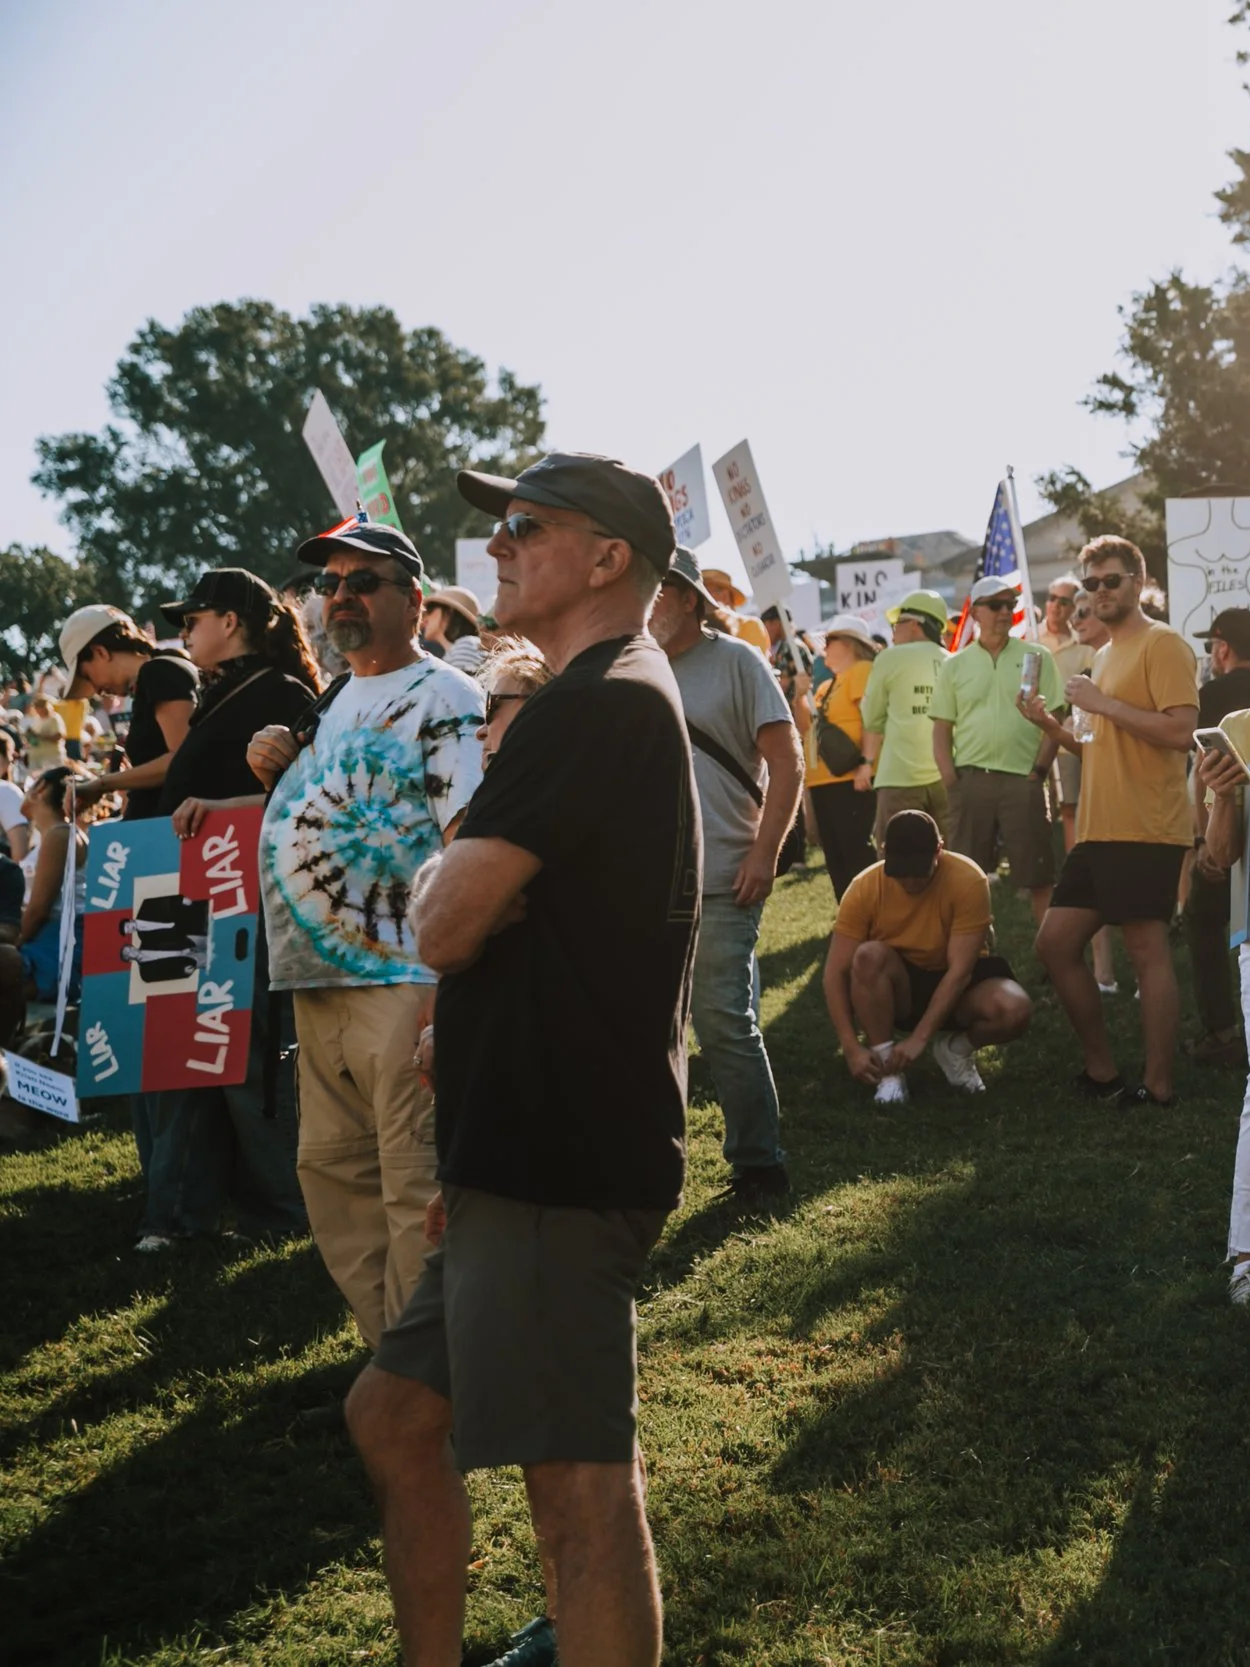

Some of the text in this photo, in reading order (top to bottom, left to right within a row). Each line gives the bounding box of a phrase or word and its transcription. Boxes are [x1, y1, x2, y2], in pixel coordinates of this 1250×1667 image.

[726, 460, 740, 480] NO
[728, 477, 752, 505] KINGS
[740, 502, 751, 518] NO
[854, 569, 888, 587] NO
[1221, 564, 1239, 575] the
[1207, 580, 1246, 595] FILES
[840, 591, 877, 610] KIN
[90, 841, 131, 910] LIAR
[202, 824, 249, 920] LIAR
[185, 979, 235, 1074] LIAR
[85, 1021, 120, 1083] LIAR
[17, 1080, 68, 1106] MEOW
